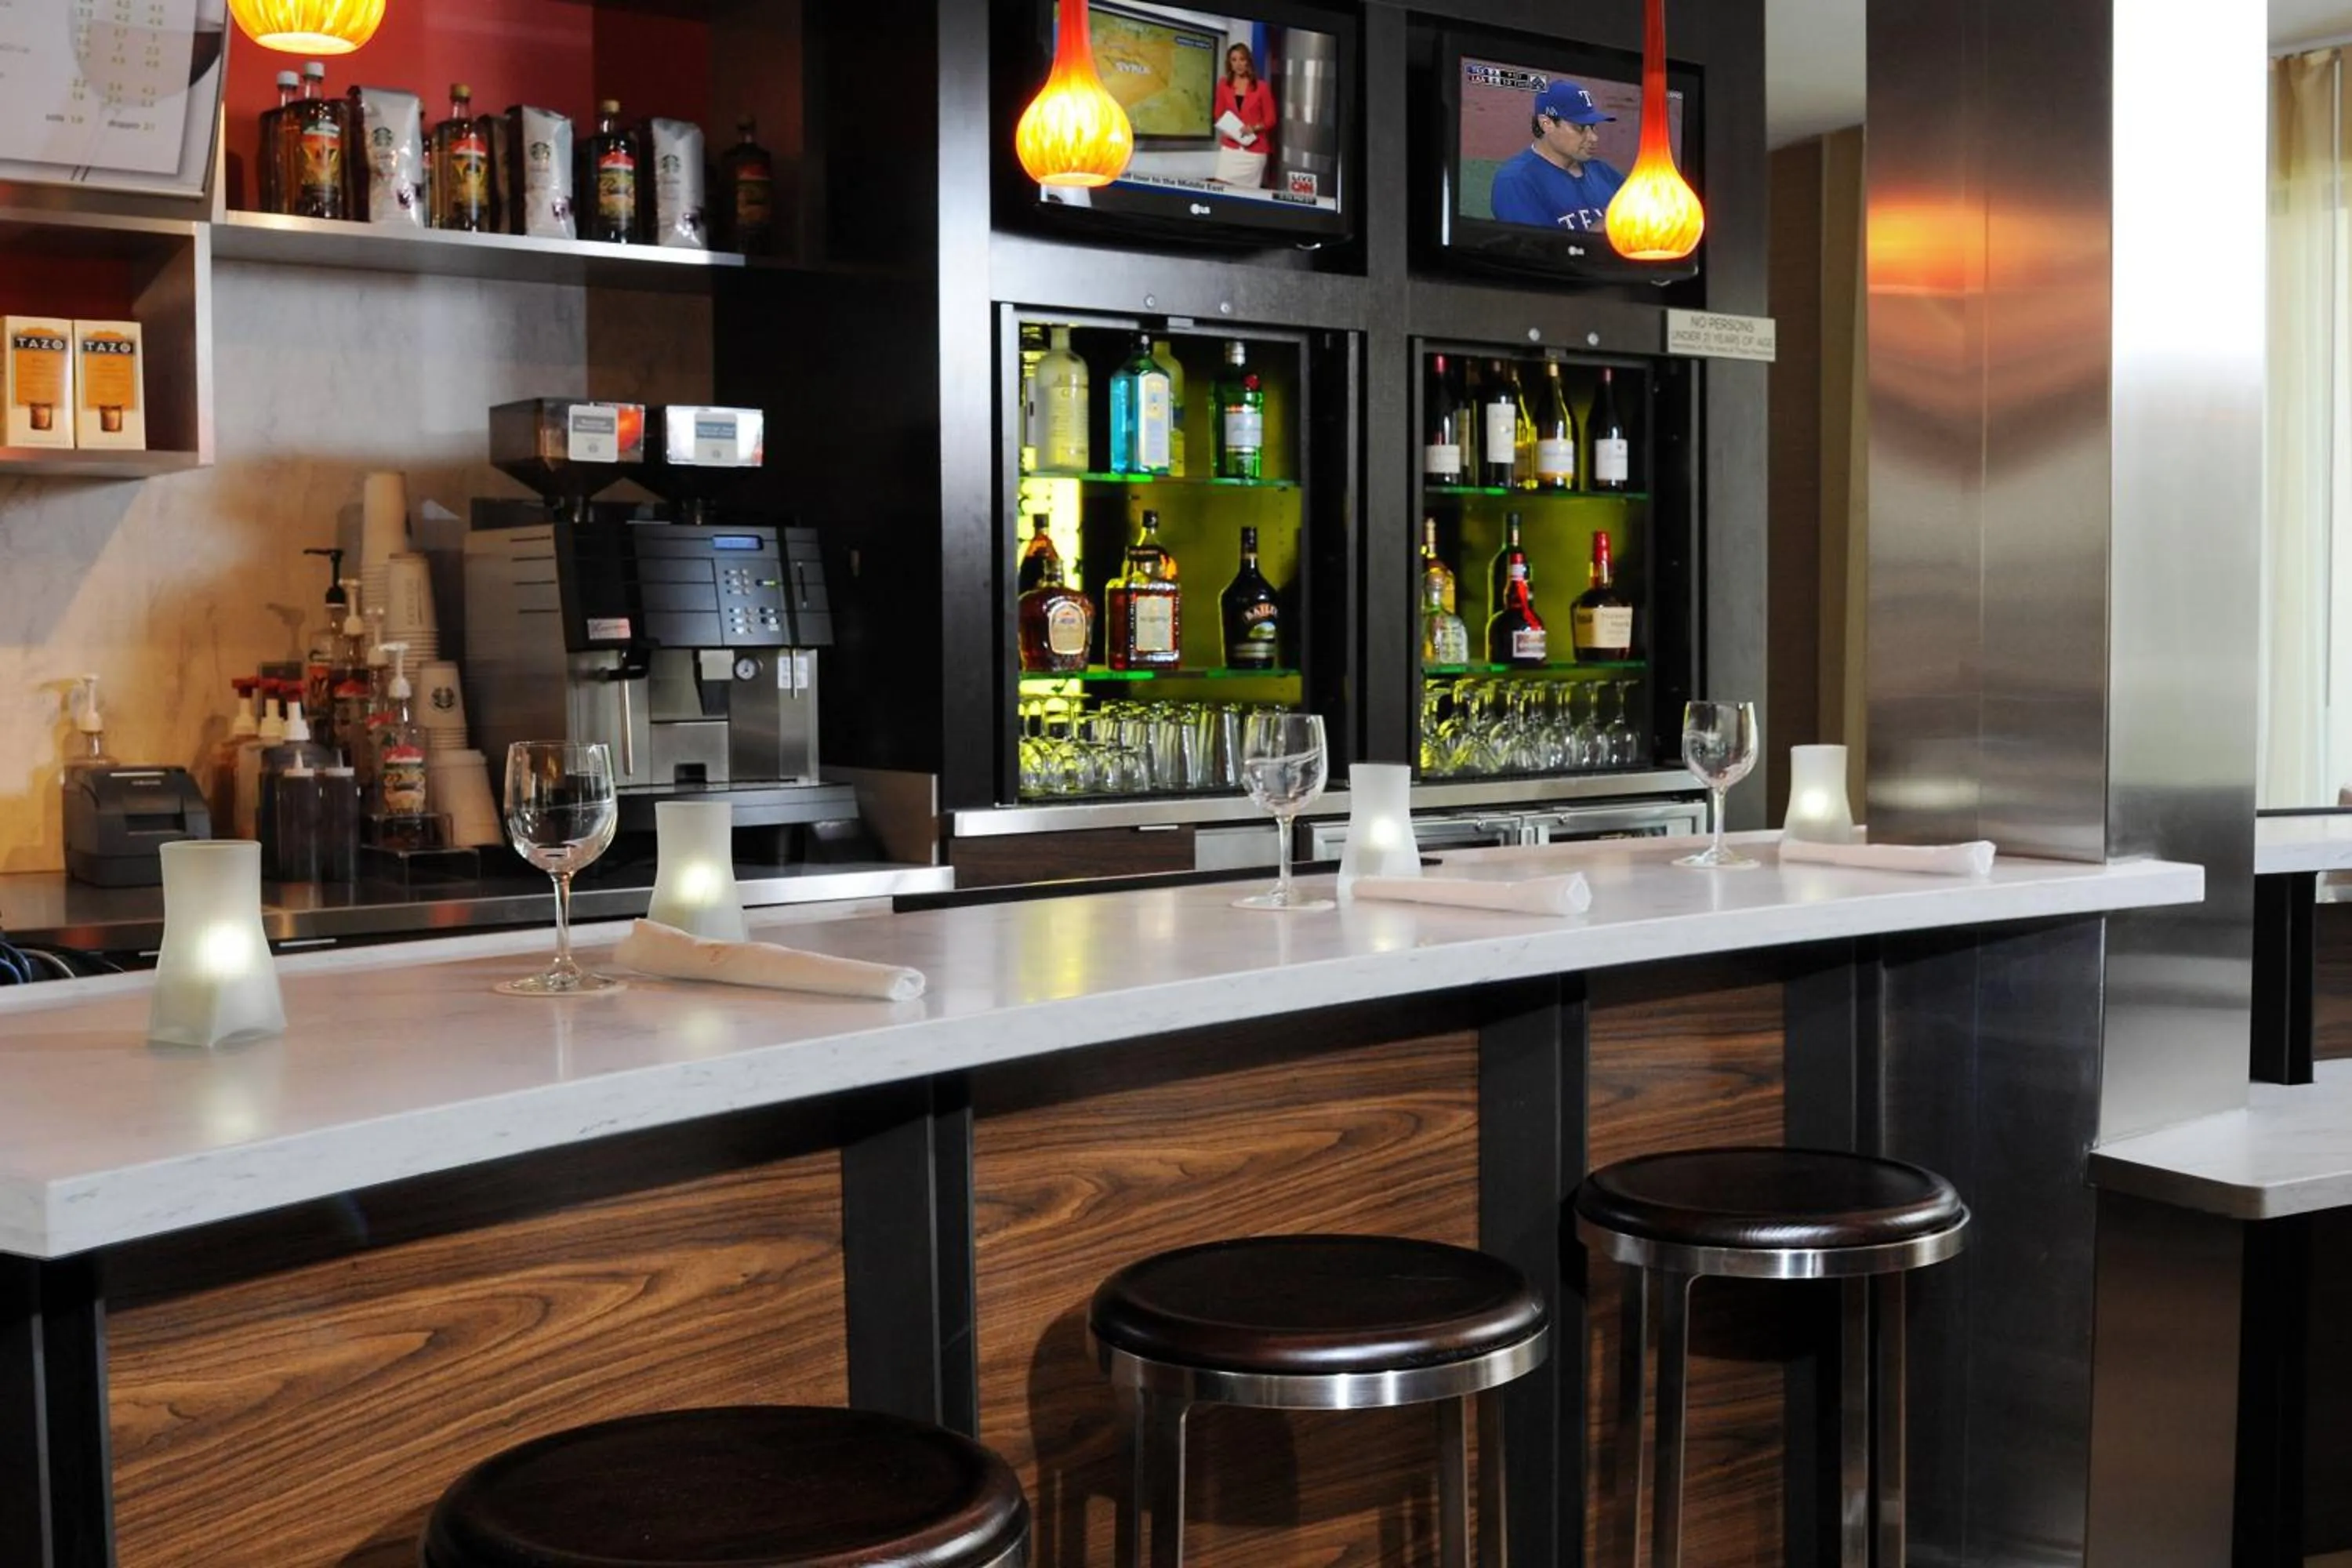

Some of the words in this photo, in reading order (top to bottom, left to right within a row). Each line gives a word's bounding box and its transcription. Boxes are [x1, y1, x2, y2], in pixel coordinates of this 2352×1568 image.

[1577, 90, 1592, 107] T
[1290, 172, 1317, 183] LIVE
[1290, 180, 1316, 194] CNN
[1690, 315, 1707, 328] NO
[1708, 317, 1755, 333] PERSONS
[17, 338, 64, 350] TAZO
[1671, 329, 1701, 341] UNDER
[1711, 332, 1740, 345] YEARS
[1741, 335, 1755, 347] OF
[1756, 336, 1773, 349] AGE
[85, 342, 131, 352] TAZO
